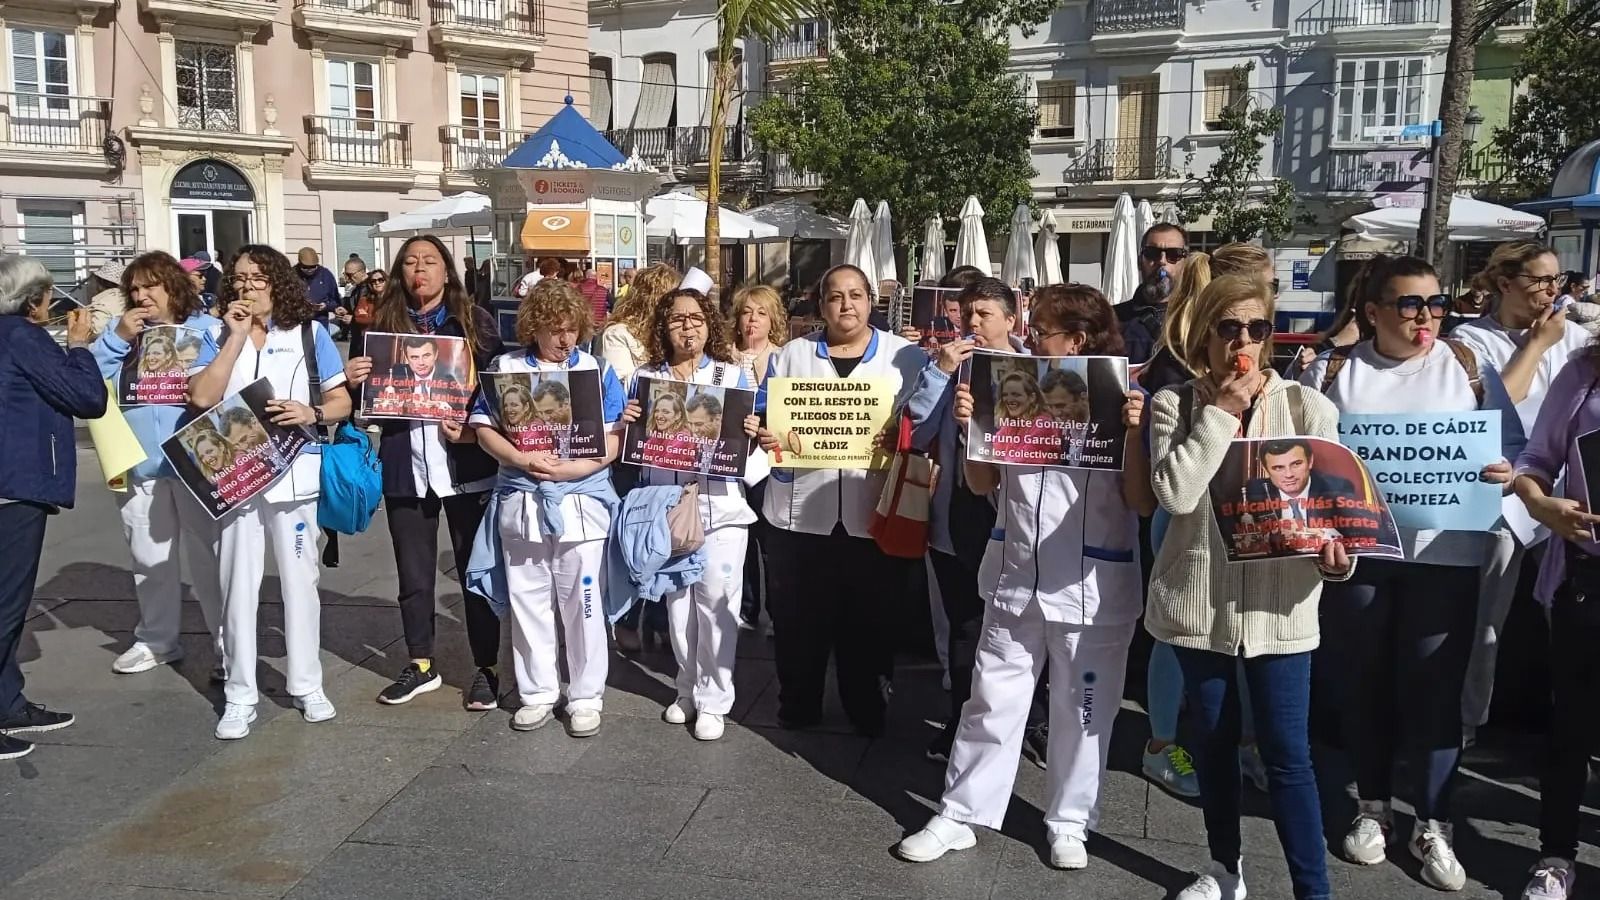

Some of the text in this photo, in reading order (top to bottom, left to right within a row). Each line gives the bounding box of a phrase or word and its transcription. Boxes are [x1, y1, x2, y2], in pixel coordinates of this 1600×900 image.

[598, 186, 631, 195] VISITORS
[1072, 221, 1112, 229] RESTAURANTE
[142, 370, 167, 378] Maite
[160, 382, 189, 390] García
[372, 378, 380, 386] El
[791, 383, 871, 391] DESIGUALDAD
[783, 397, 879, 406] CON EL RESTO DE
[790, 412, 872, 421] PLIEGOS DE LA
[530, 423, 572, 432] González
[573, 423, 579, 432] y
[791, 427, 871, 435] PROVINCIA DE
[999, 417, 1099, 433] Maite González y
[1337, 418, 1487, 435] L AYTO. DE CÁDIZ
[522, 436, 553, 445] García
[649, 430, 726, 449] Maite González y
[813, 440, 848, 450] CÁDIZ
[984, 433, 1020, 443] Bruno
[1023, 434, 1061, 446] García
[553, 447, 562, 455] de
[564, 447, 598, 456] Limpieza
[637, 441, 664, 451] Bruno
[666, 445, 696, 456] García
[1357, 446, 1467, 461] BANDONA
[211, 434, 280, 482] Maite González y
[978, 447, 1113, 464] de los Colectivos de Limpieza
[631, 452, 641, 460] de
[642, 453, 653, 462] los
[654, 456, 692, 467] Colectivos
[704, 463, 738, 473] Limpieza
[225, 494, 237, 504] los
[236, 472, 271, 497] Colectivos
[271, 465, 280, 473] de
[280, 437, 305, 466] Limpieza
[210, 479, 238, 499] Bruno
[237, 460, 265, 482] García
[1386, 493, 1461, 505] IMPIEZA
[1236, 500, 1289, 514] Alcalde
[1309, 517, 1379, 529] Maltrata
[583, 588, 592, 619] LIMASA
[1082, 688, 1093, 724] LIMASA
